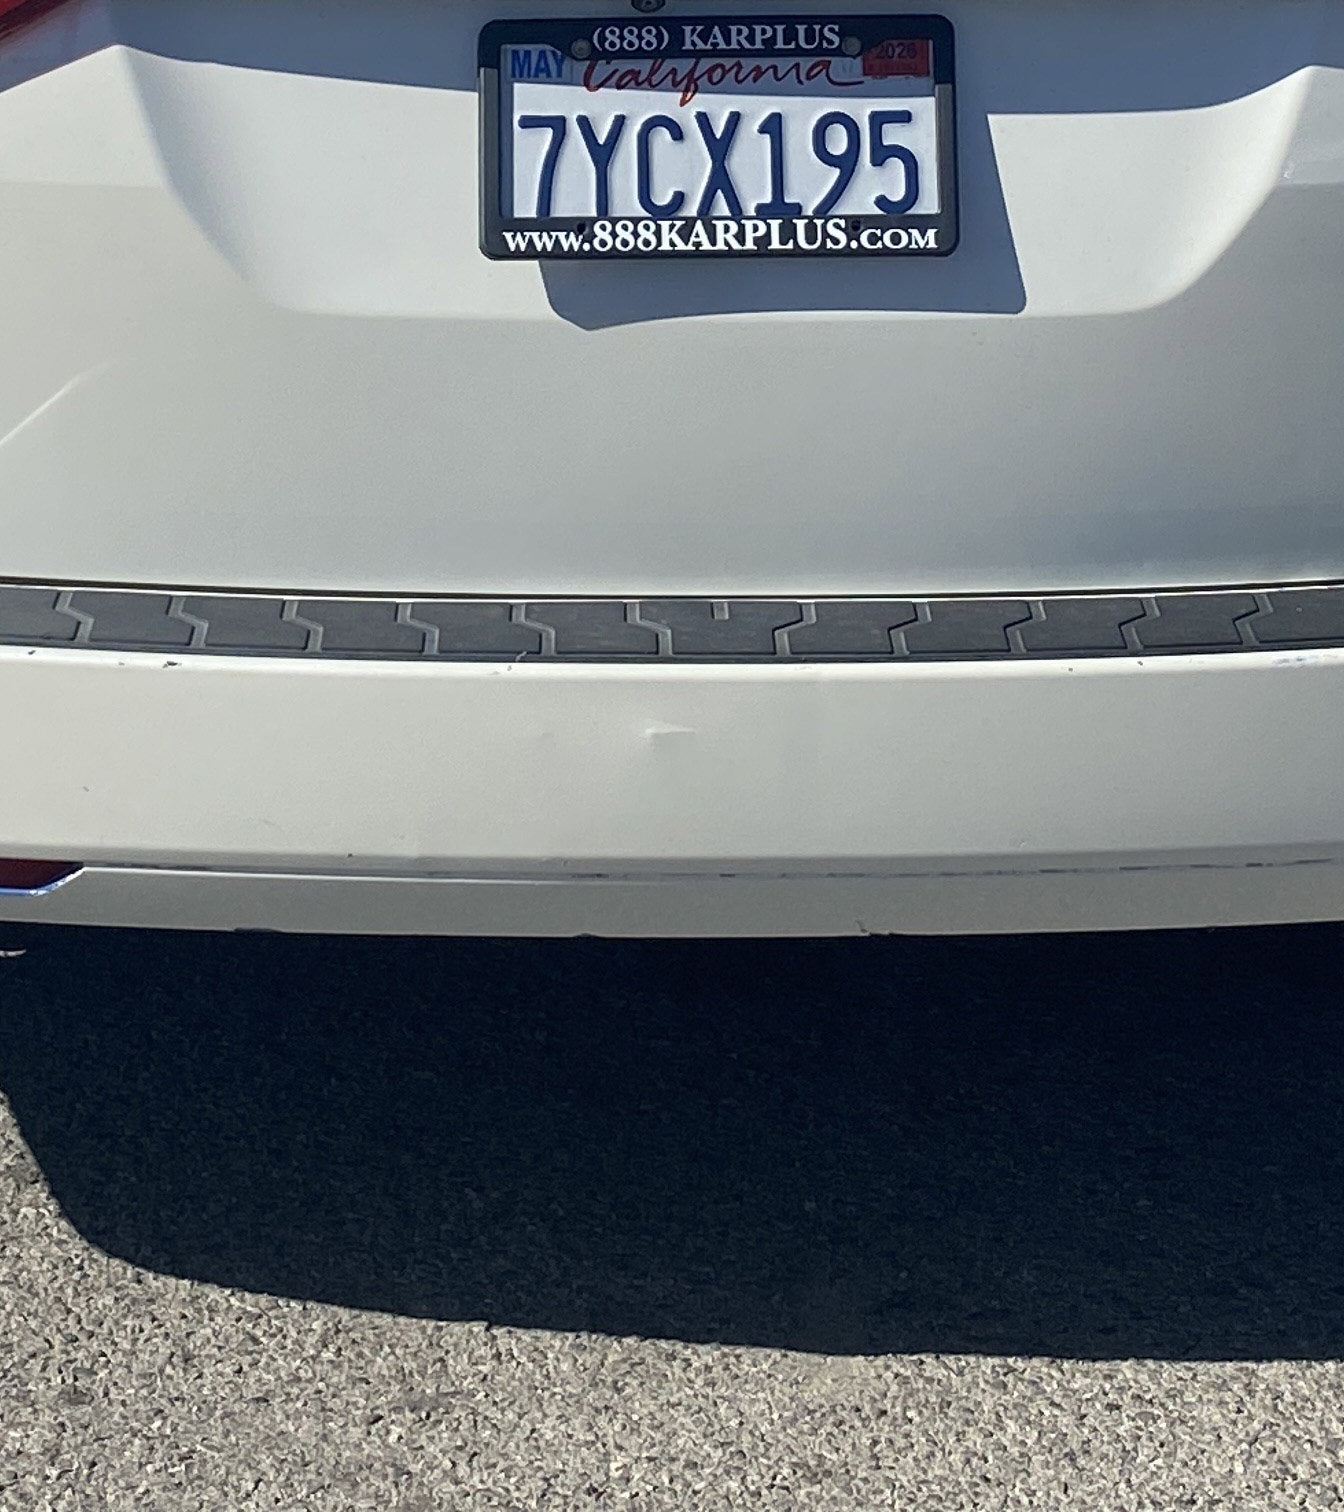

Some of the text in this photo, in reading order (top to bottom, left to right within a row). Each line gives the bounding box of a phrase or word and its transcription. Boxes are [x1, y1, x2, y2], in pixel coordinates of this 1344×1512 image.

[592, 23, 840, 52] (888) KARPLUS
[511, 49, 565, 78] MAY
[583, 55, 864, 106] California
[518, 110, 919, 217] 7YCX195
[503, 219, 939, 251] www.888KARPLUS.COM
